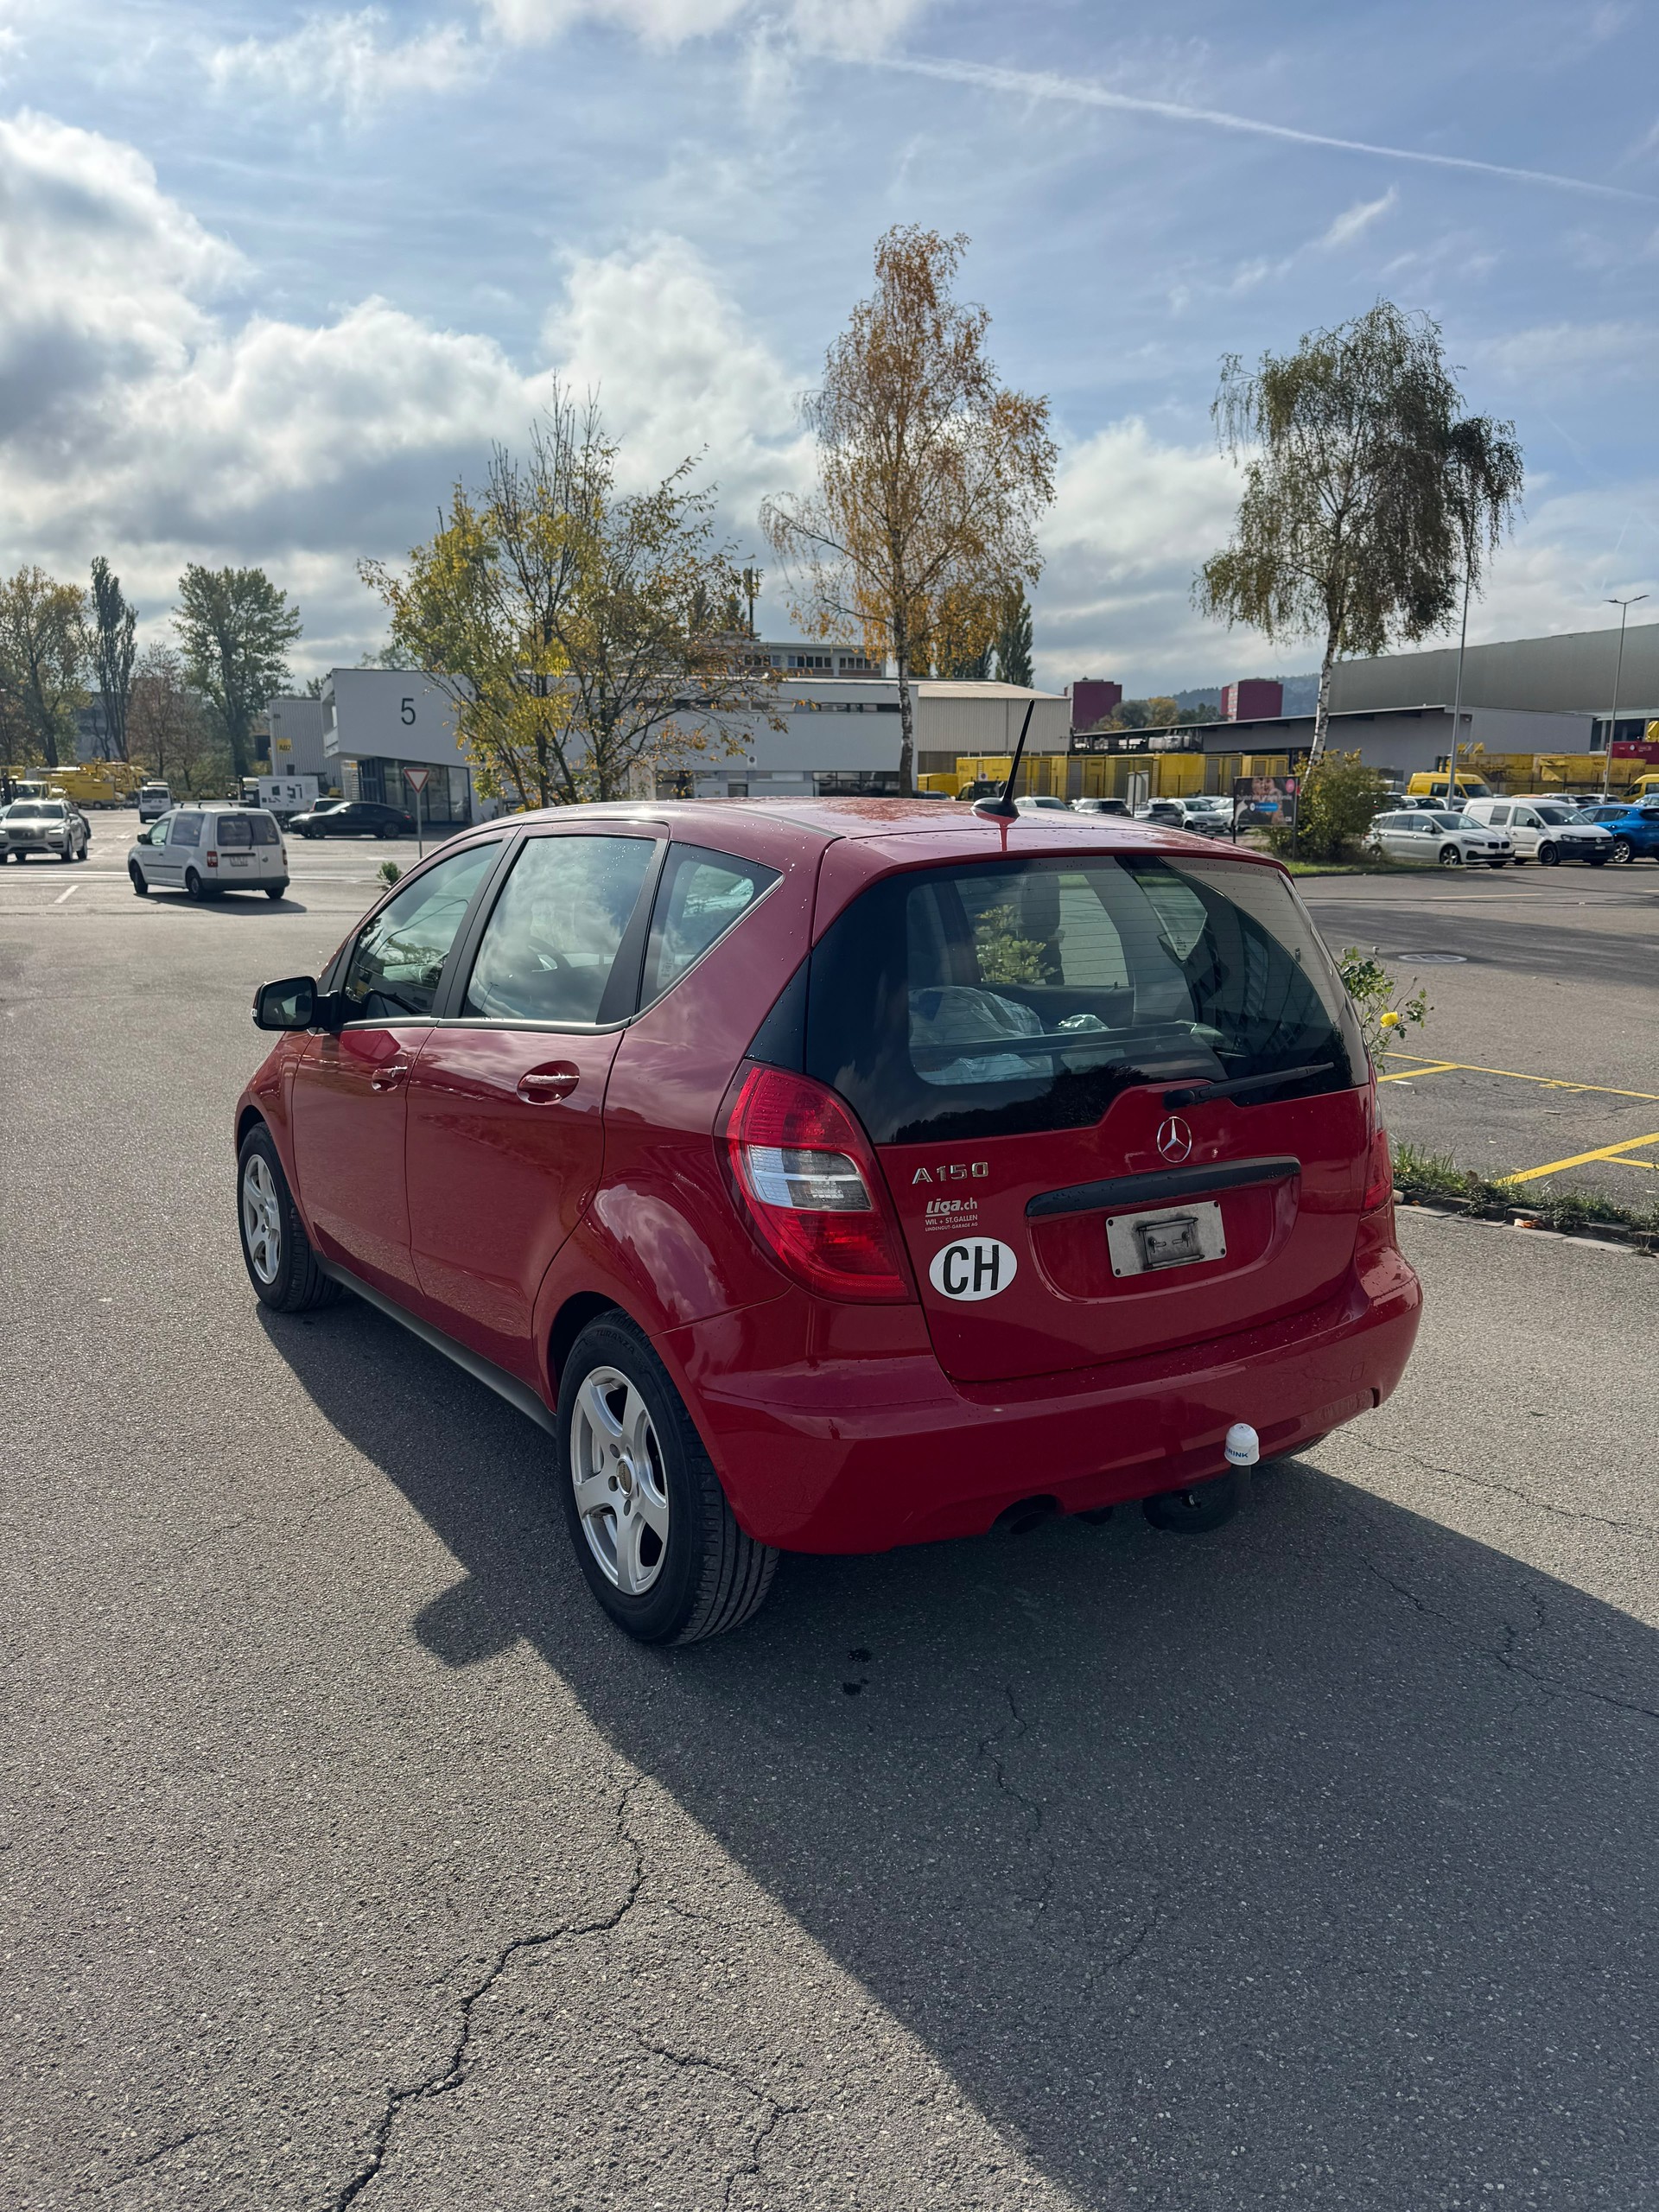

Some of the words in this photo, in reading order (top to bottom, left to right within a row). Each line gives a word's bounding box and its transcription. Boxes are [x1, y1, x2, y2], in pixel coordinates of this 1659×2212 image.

[401, 698, 416, 725] 5
[925, 1197, 978, 1217] Liga.ch
[945, 1214, 978, 1224] ST.GALLEN
[943, 1244, 1000, 1295] CH
